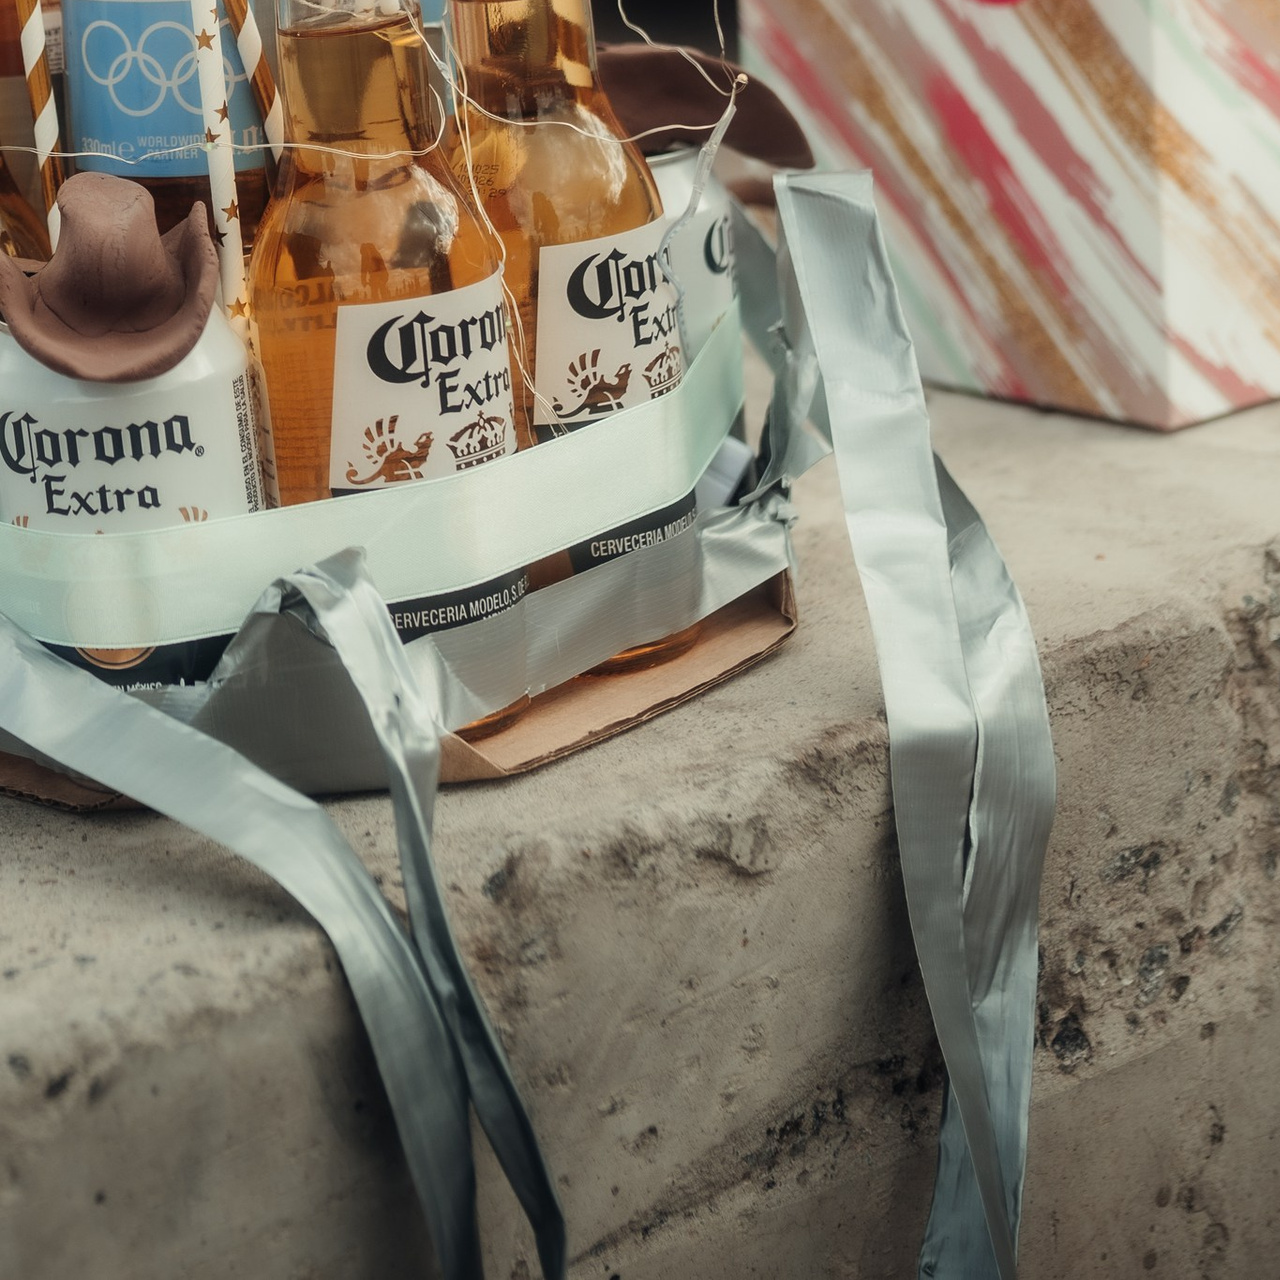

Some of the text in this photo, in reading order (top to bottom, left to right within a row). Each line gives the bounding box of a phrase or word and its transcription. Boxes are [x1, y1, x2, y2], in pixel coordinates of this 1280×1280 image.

[434, 367, 510, 416] Extra
[42, 474, 161, 516] Extra
[591, 528, 663, 557] CERVECERIA
[390, 604, 467, 629] ERVECERIA
